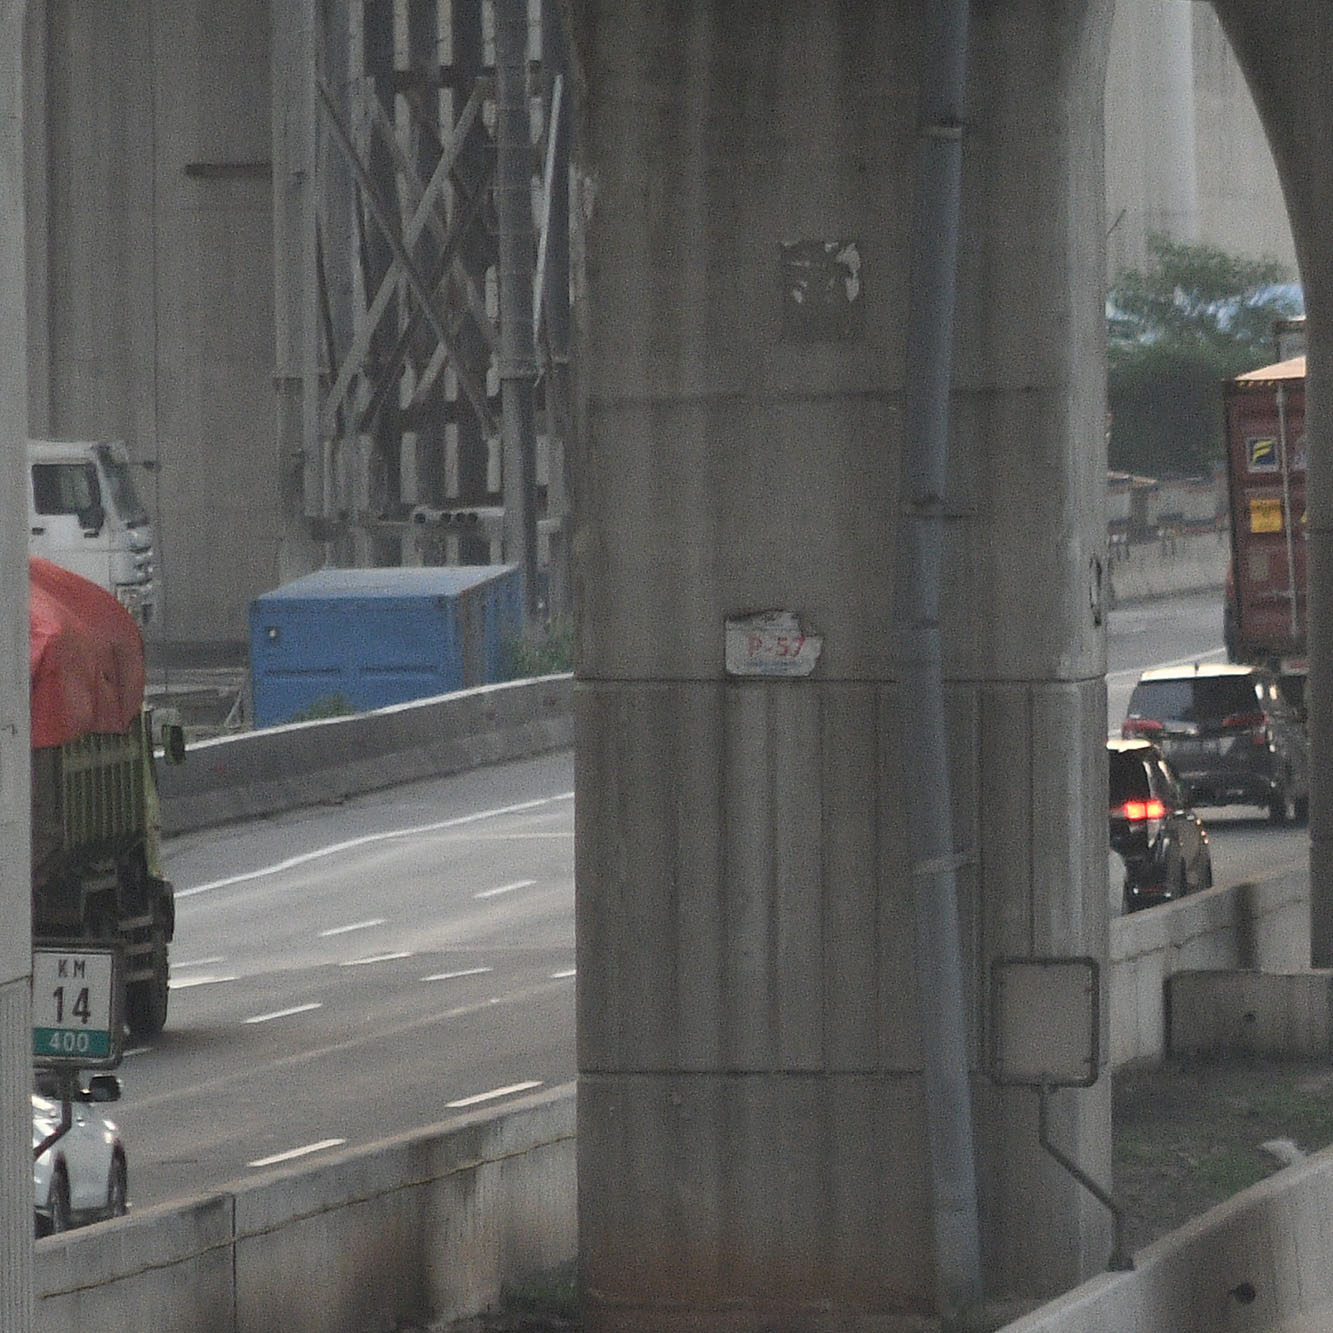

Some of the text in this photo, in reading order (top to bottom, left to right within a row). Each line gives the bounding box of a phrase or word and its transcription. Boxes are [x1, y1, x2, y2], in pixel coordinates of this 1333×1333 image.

[58, 960, 86, 978] KM
[53, 986, 91, 1024] 14
[49, 1031, 89, 1052] 400
